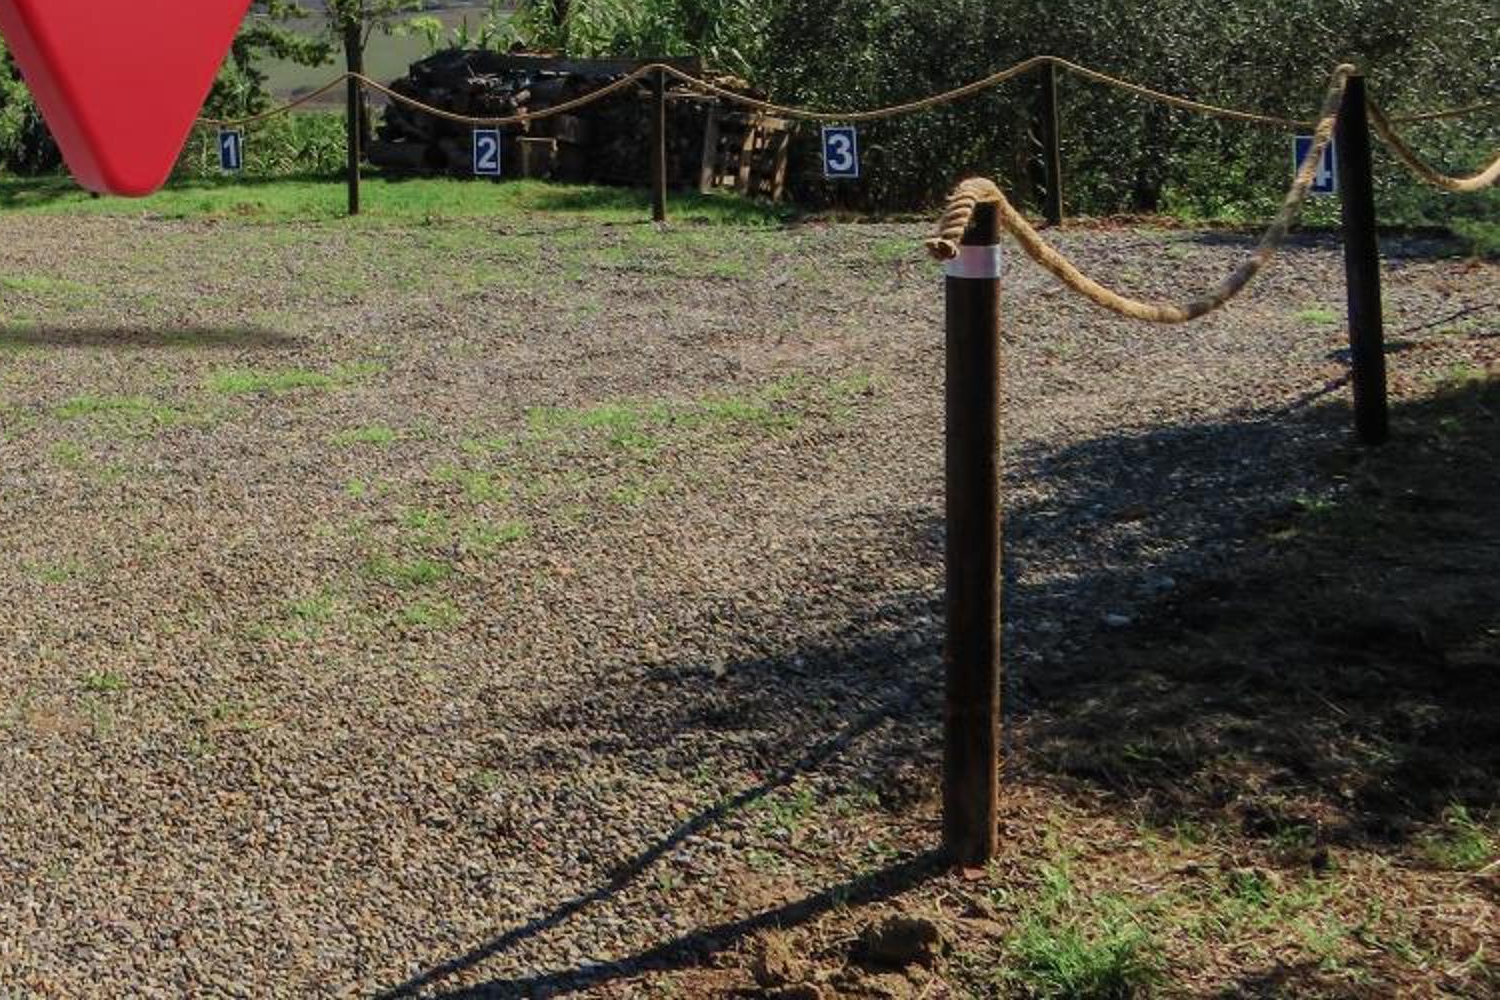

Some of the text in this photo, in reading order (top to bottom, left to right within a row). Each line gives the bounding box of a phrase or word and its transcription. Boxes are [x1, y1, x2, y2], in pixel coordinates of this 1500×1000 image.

[223, 135, 237, 167] 1
[478, 137, 496, 169] 2
[828, 133, 853, 170] 3
